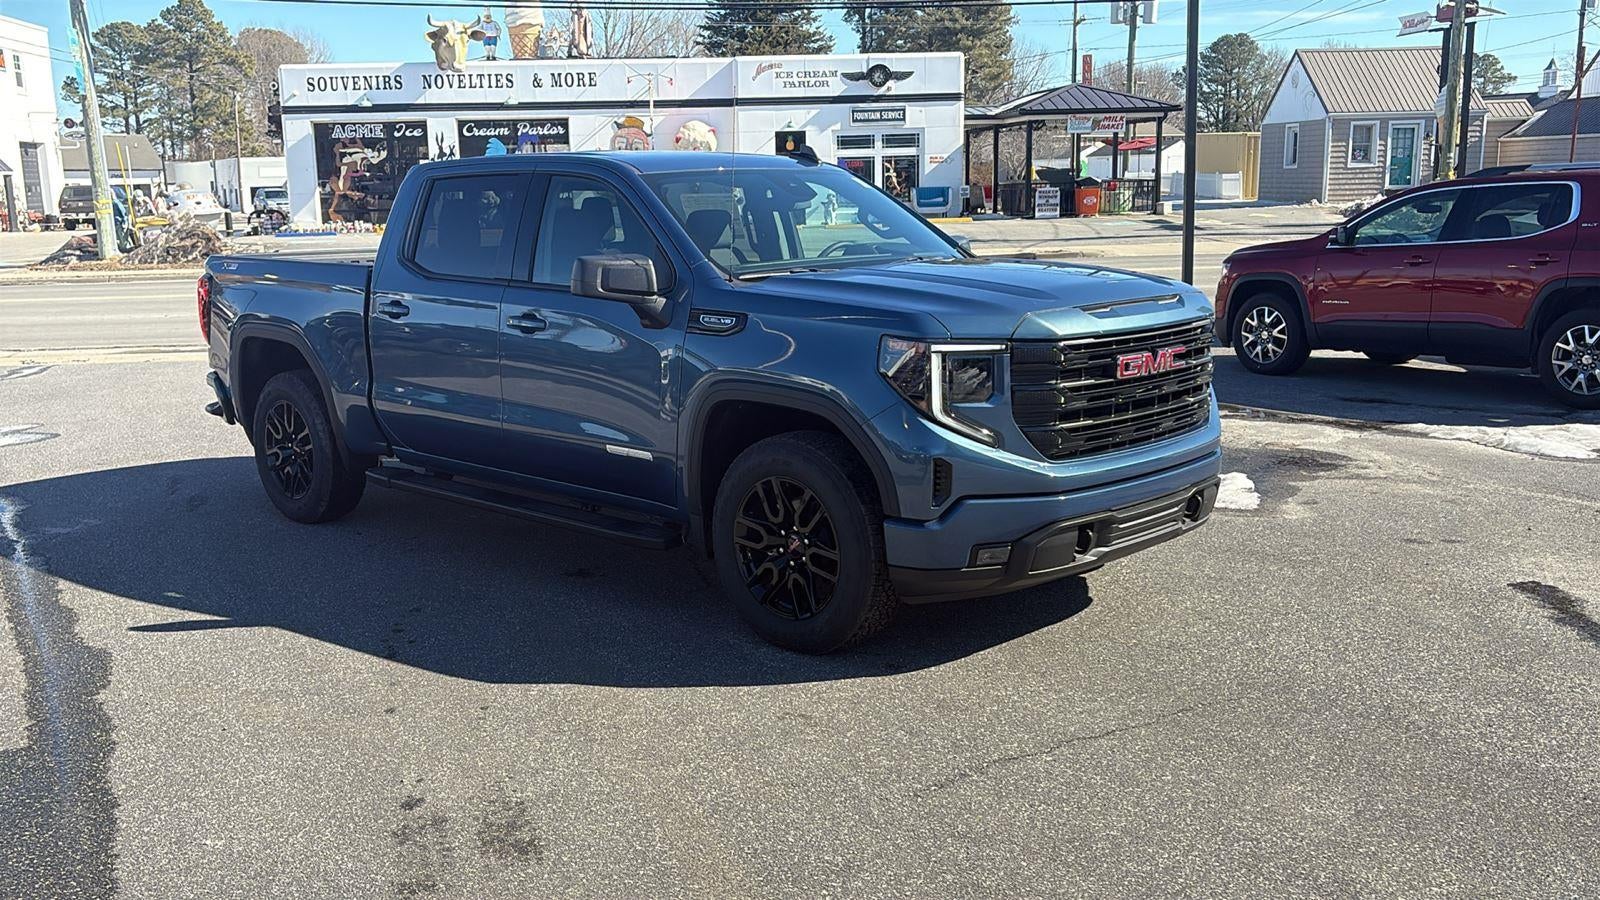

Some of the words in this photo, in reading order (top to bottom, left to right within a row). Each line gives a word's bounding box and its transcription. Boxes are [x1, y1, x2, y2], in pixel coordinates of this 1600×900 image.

[775, 71, 793, 79] ICE
[796, 70, 838, 79] CREAM
[306, 74, 403, 92] SOUVENIRS
[421, 73, 514, 90] NOVELTIES
[532, 72, 543, 88] &
[550, 72, 597, 88] MORE
[782, 80, 830, 88] PARLOR
[853, 111, 880, 120] FOUNTAIN
[881, 110, 904, 119] SERVICE
[1103, 115, 1126, 123] MILK
[331, 124, 384, 138] ACME
[393, 123, 425, 137] Ice
[462, 122, 511, 137] Cream
[516, 122, 566, 136] Parlor
[1117, 345, 1186, 379] GMC
